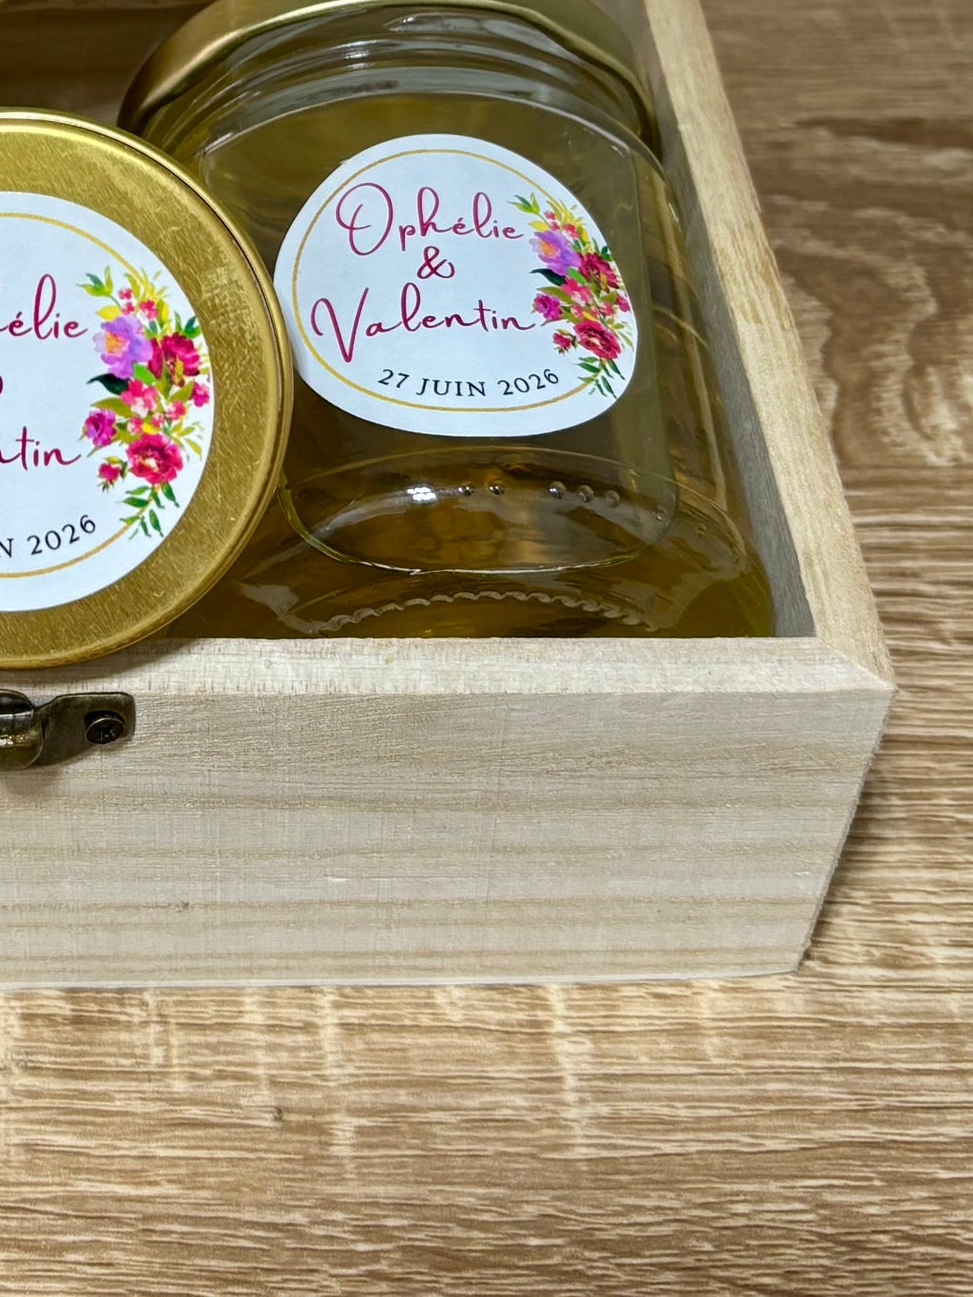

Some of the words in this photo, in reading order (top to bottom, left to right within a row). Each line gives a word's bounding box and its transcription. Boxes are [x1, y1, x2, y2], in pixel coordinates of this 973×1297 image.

[335, 182, 524, 256] Ophélie
[416, 245, 455, 279] &
[311, 282, 535, 363] Valentin
[378, 369, 410, 389] 27
[416, 378, 486, 397] JUIN
[497, 368, 559, 396] 2026
[27, 514, 96, 556] 2026
